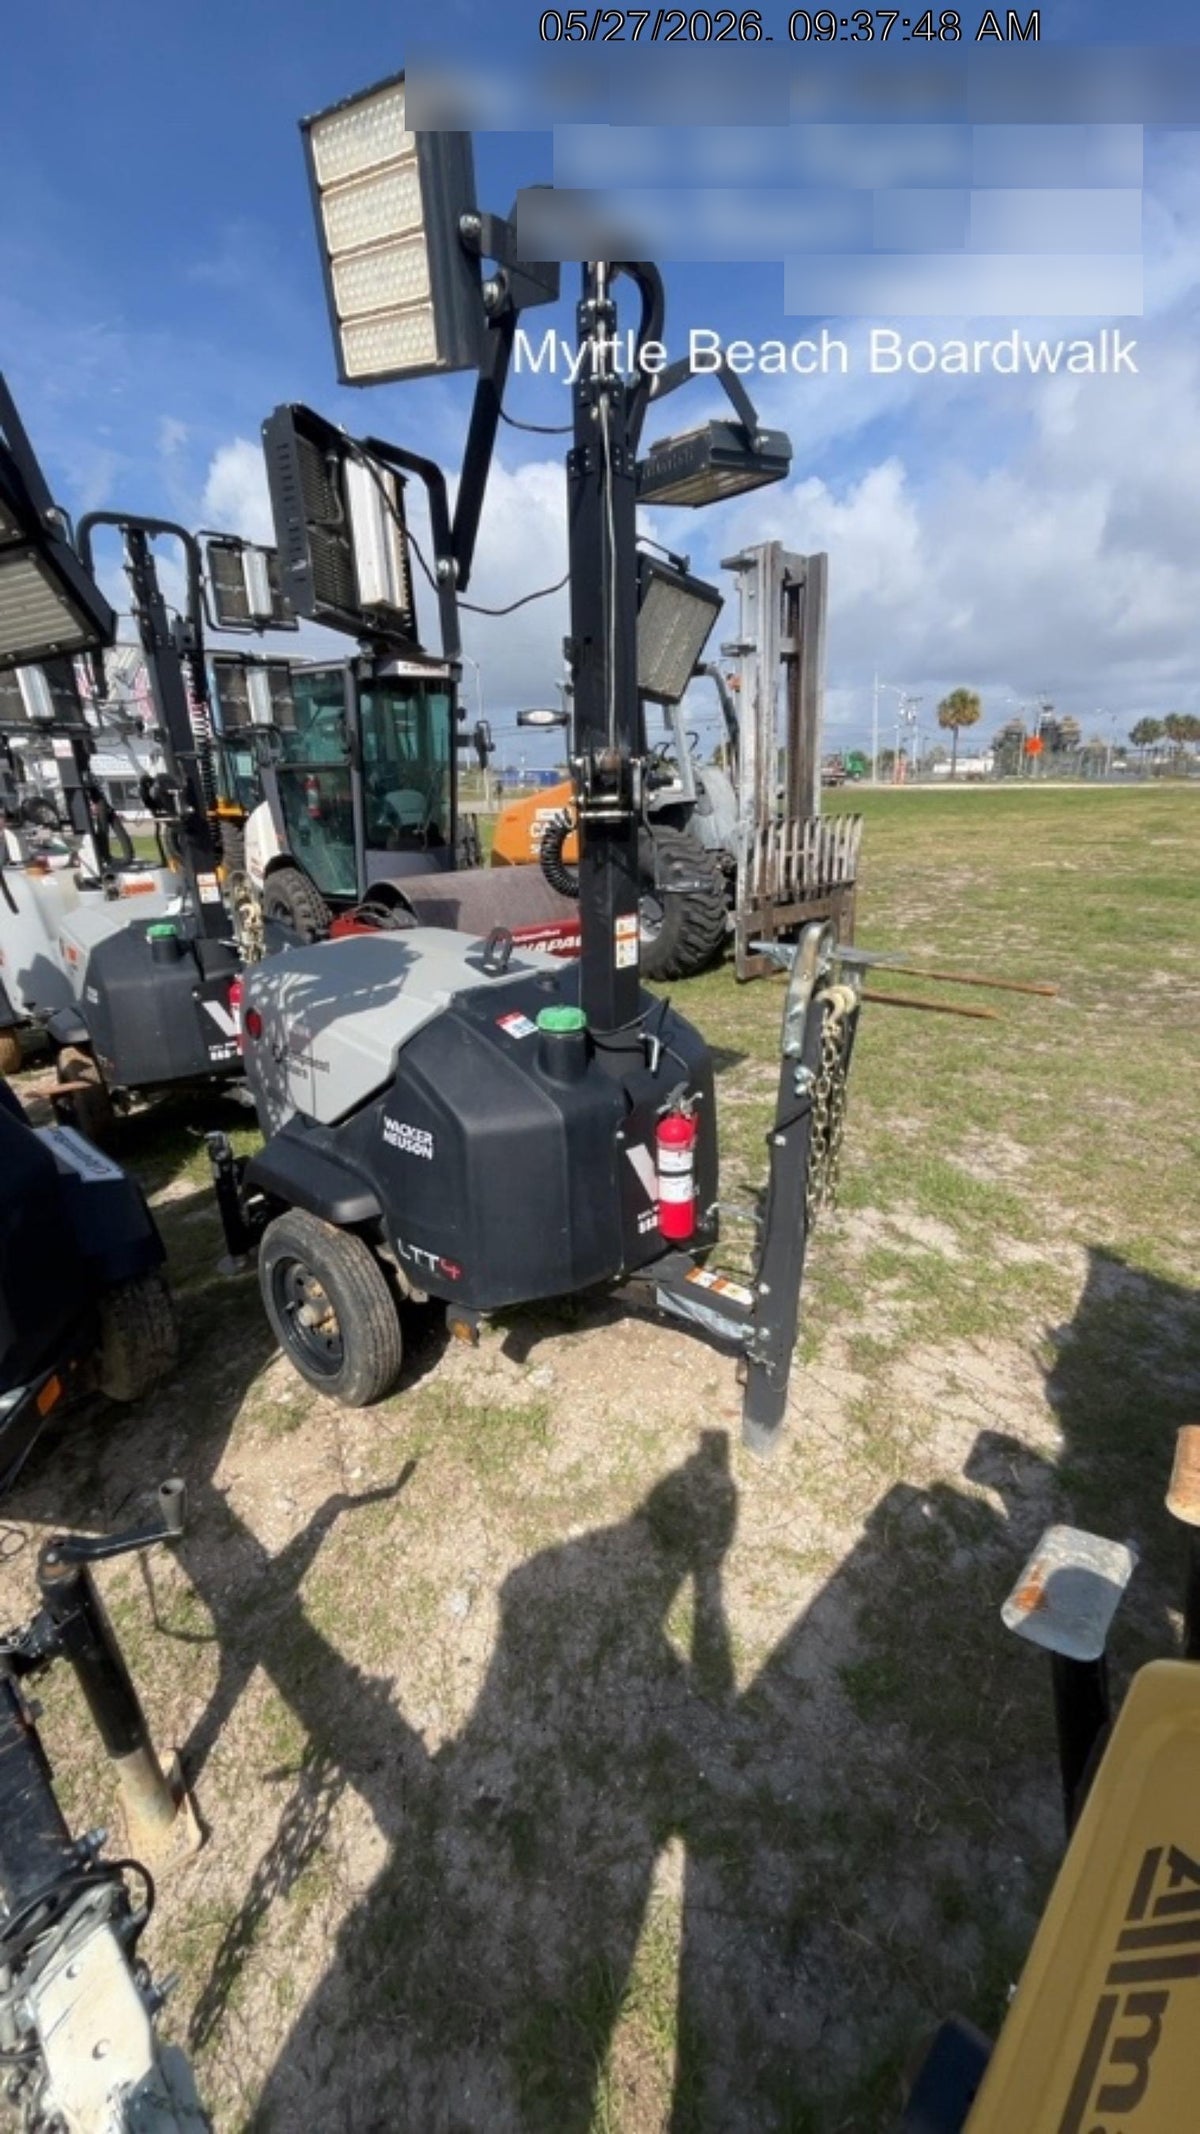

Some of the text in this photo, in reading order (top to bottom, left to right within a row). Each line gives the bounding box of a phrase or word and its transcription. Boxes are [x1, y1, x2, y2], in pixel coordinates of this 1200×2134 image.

[383, 1115, 433, 1146] WACKER
[383, 1129, 434, 1161] NEUSON
[398, 1238, 462, 1281] LTT4
[1070, 1845, 1200, 2134] Allm
